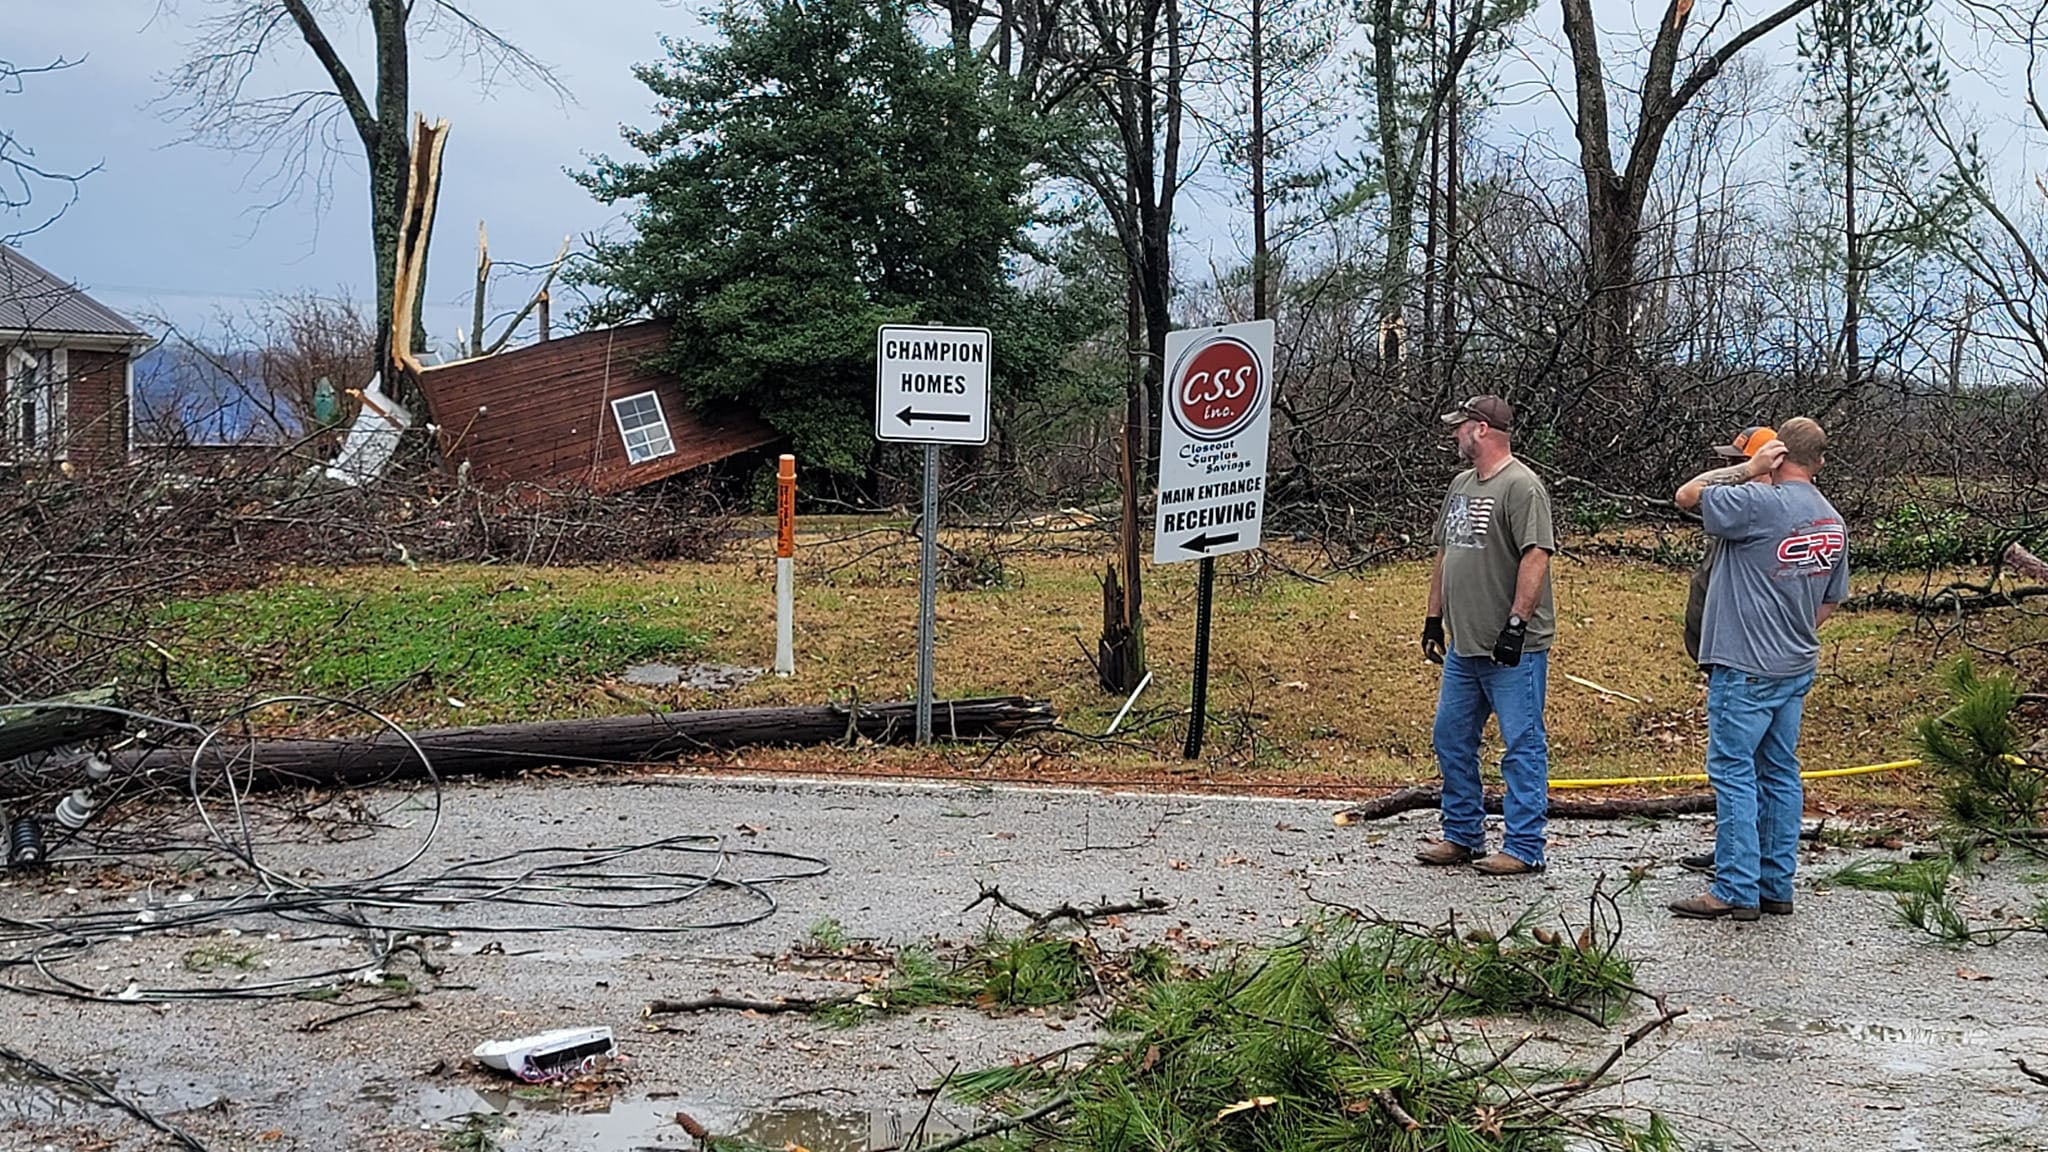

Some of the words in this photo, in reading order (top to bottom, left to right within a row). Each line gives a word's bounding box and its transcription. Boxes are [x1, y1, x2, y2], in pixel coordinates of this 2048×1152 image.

[886, 340, 983, 363] CHAMPION
[901, 373, 966, 395] HOMES
[1183, 366, 1252, 405] CSS
[1179, 440, 1235, 459] Closeout
[1187, 450, 1239, 468] Surplus
[1205, 459, 1252, 475] Savings
[1161, 486, 1196, 506] MAIN
[1198, 476, 1262, 500] ENTRANCE
[1163, 500, 1257, 533] RECEIVING
